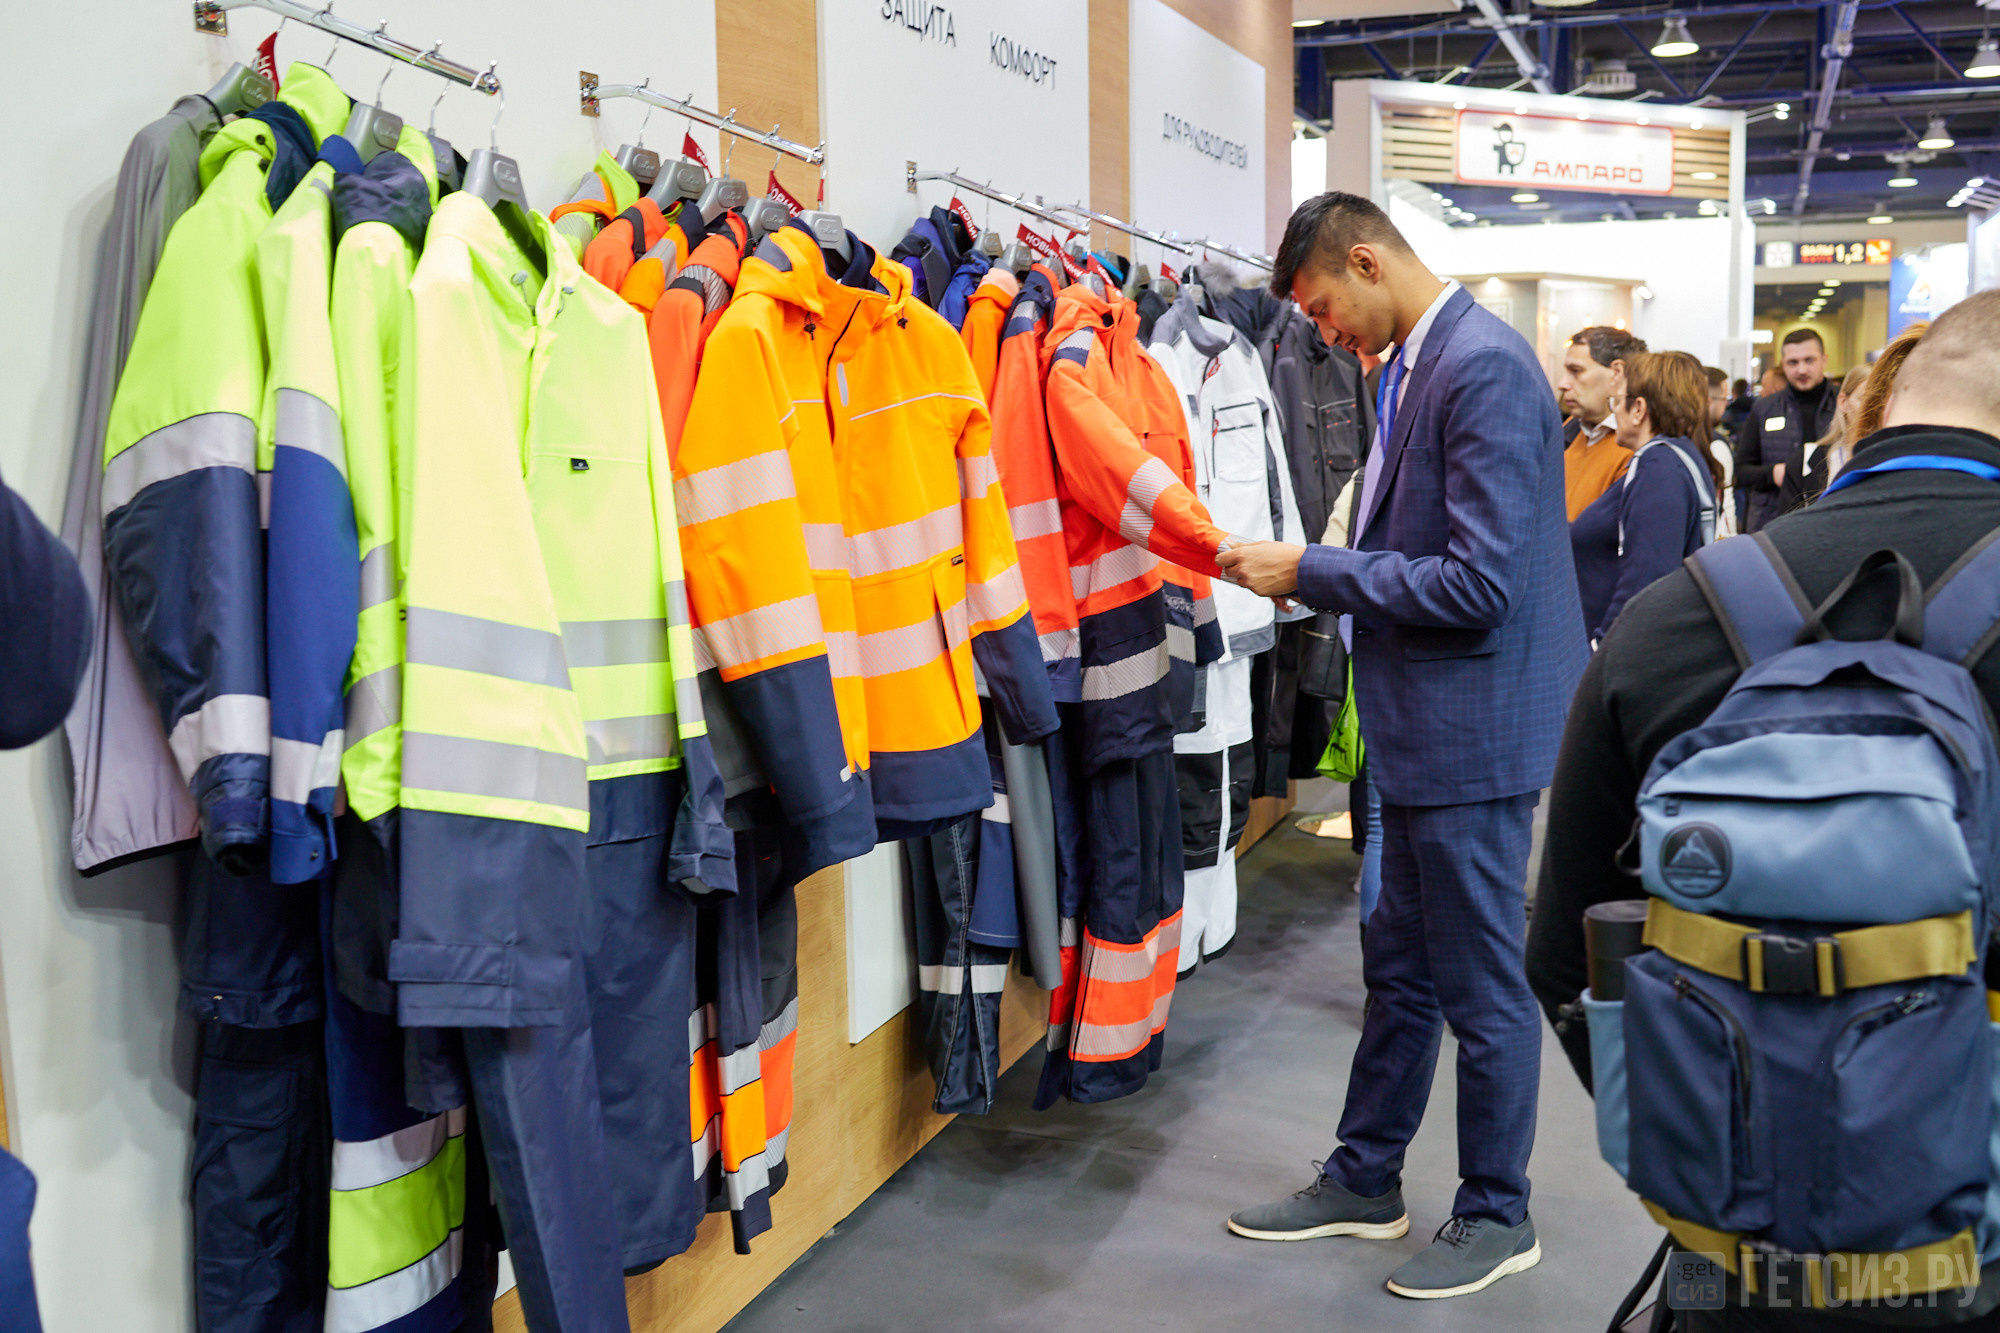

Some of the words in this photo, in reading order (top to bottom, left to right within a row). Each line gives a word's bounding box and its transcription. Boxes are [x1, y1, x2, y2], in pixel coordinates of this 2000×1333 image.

[881, 0, 956, 47] ЗАЩИТА
[990, 31, 1057, 90] КОМФОРТ
[1162, 112, 1181, 142] ДЛЯ
[1183, 121, 1248, 170] РУКОВОДИТЕЛЕЙ
[1532, 160, 1643, 184] АМПАРО
[1835, 242, 1865, 265] 1,2
